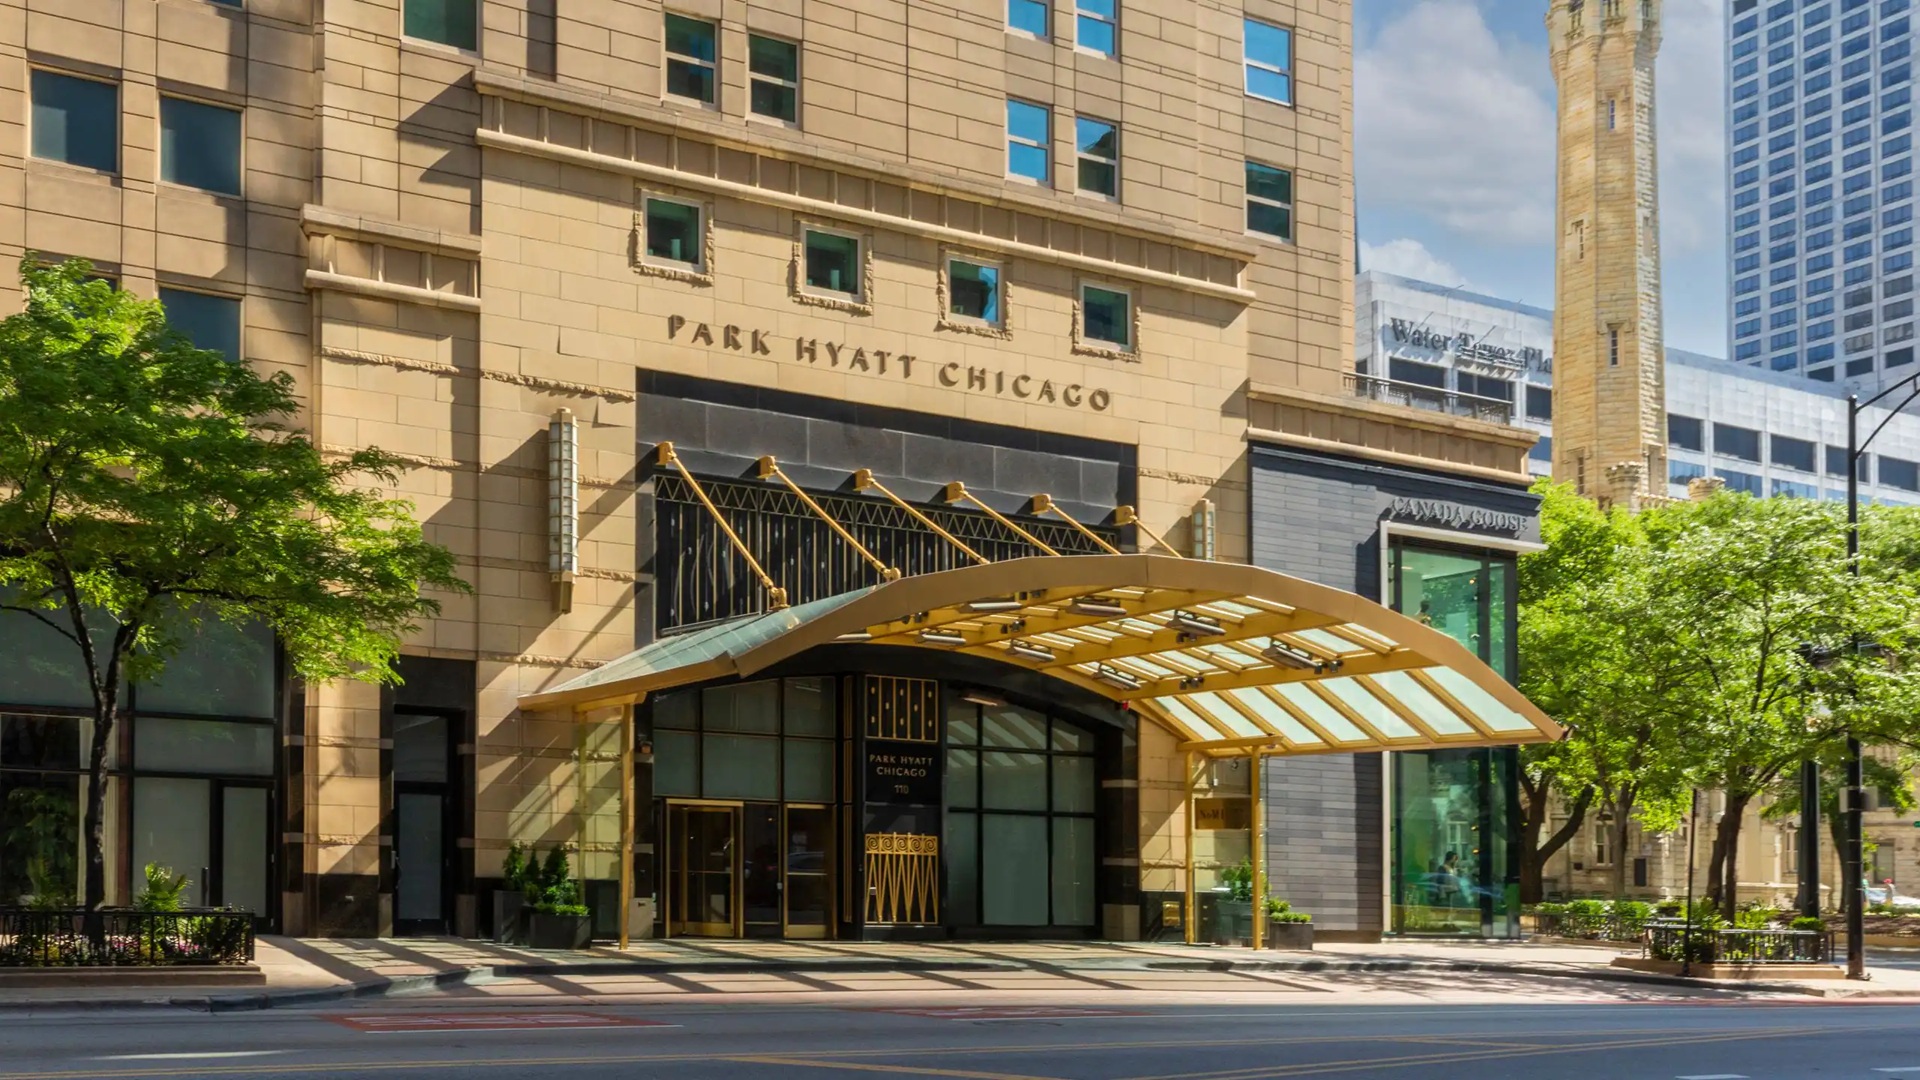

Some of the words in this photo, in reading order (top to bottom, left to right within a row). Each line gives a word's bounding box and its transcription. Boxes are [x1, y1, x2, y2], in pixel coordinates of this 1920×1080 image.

[1390, 317, 1453, 351] Water
[668, 314, 771, 355] PARK
[796, 336, 917, 379] HYATT
[938, 361, 1110, 411] CHICAGO
[1392, 497, 1467, 523] CANADA
[1470, 510, 1528, 531] GOOSE
[869, 754, 896, 764] PARK
[900, 756, 933, 766] HYATT
[876, 766, 926, 777] CHICAGO
